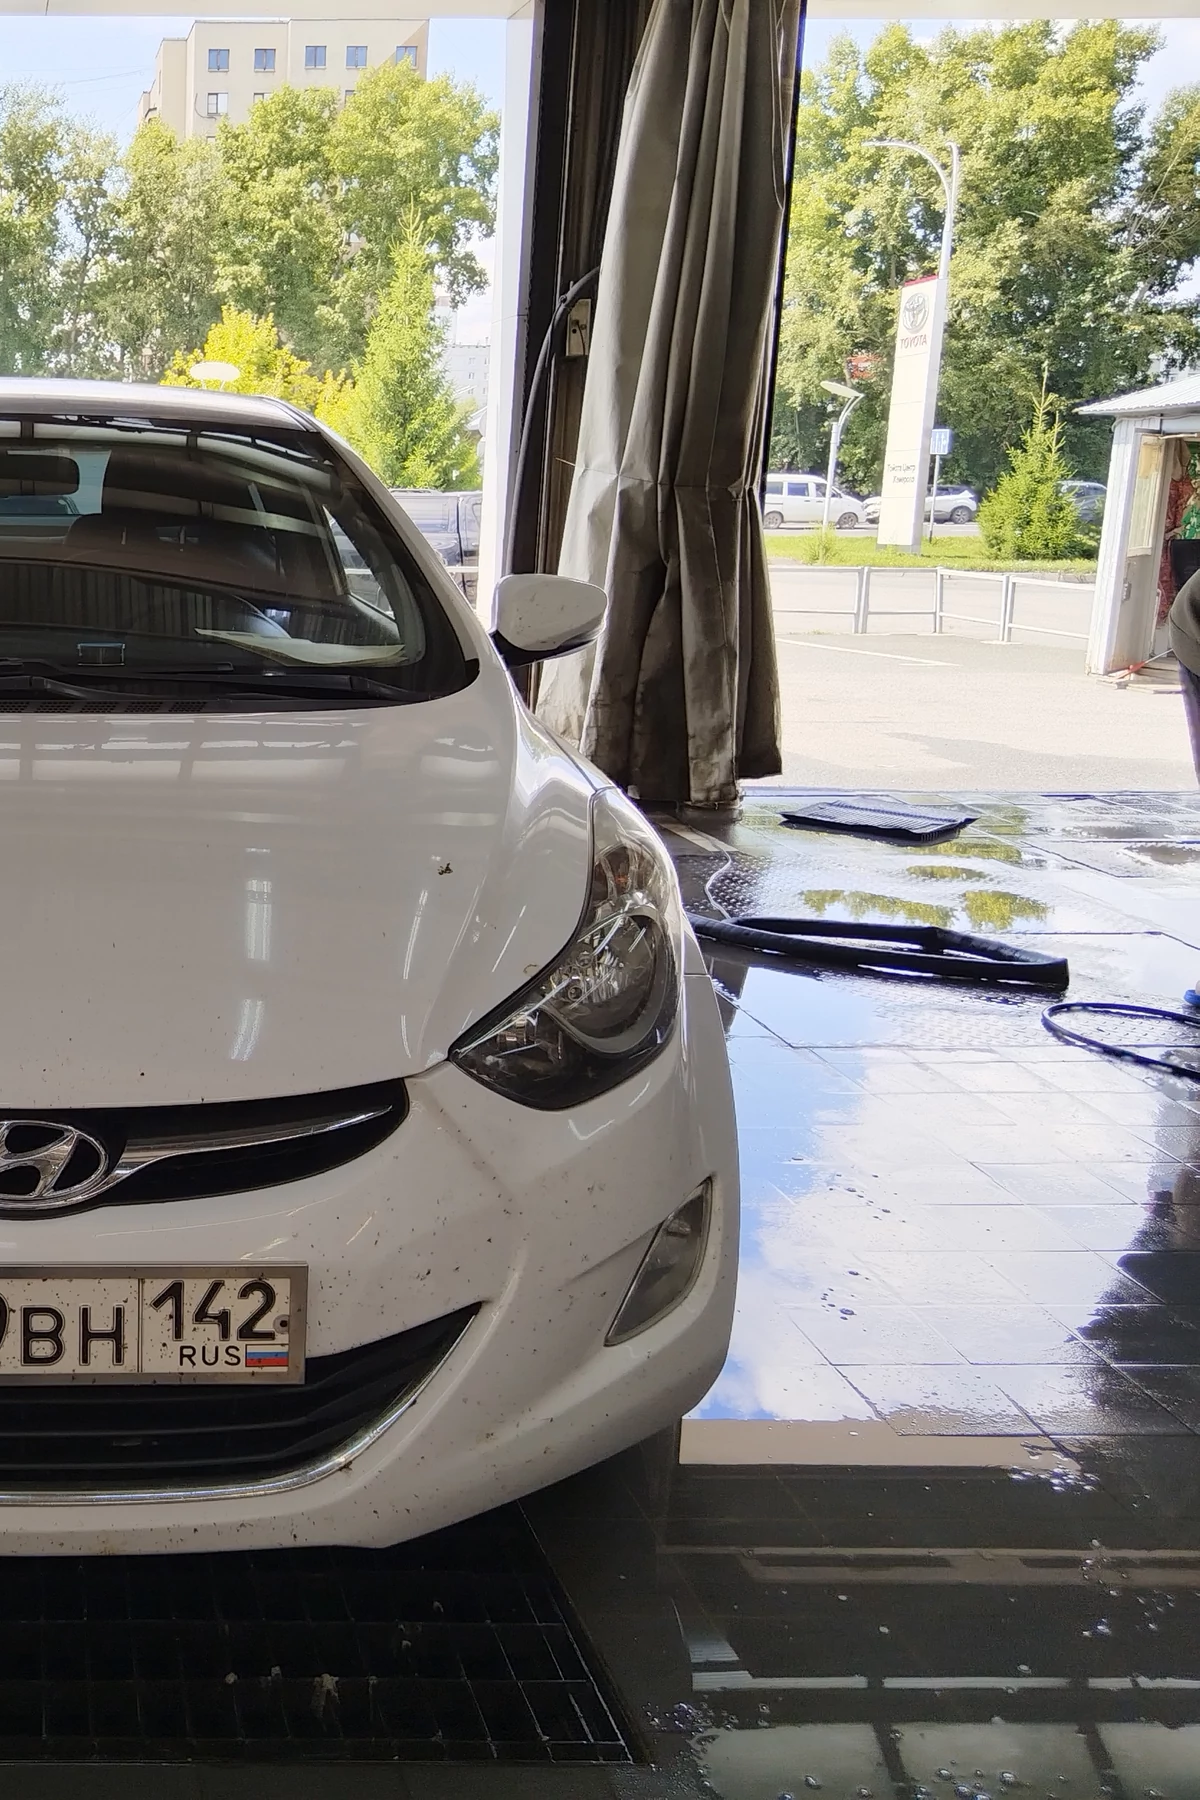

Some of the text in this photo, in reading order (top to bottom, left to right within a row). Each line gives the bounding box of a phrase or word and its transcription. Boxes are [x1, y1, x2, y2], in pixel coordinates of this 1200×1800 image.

[900, 334, 927, 349] TOYOTA
[148, 1280, 275, 1342] 142
[178, 1345, 241, 1367] RUS
